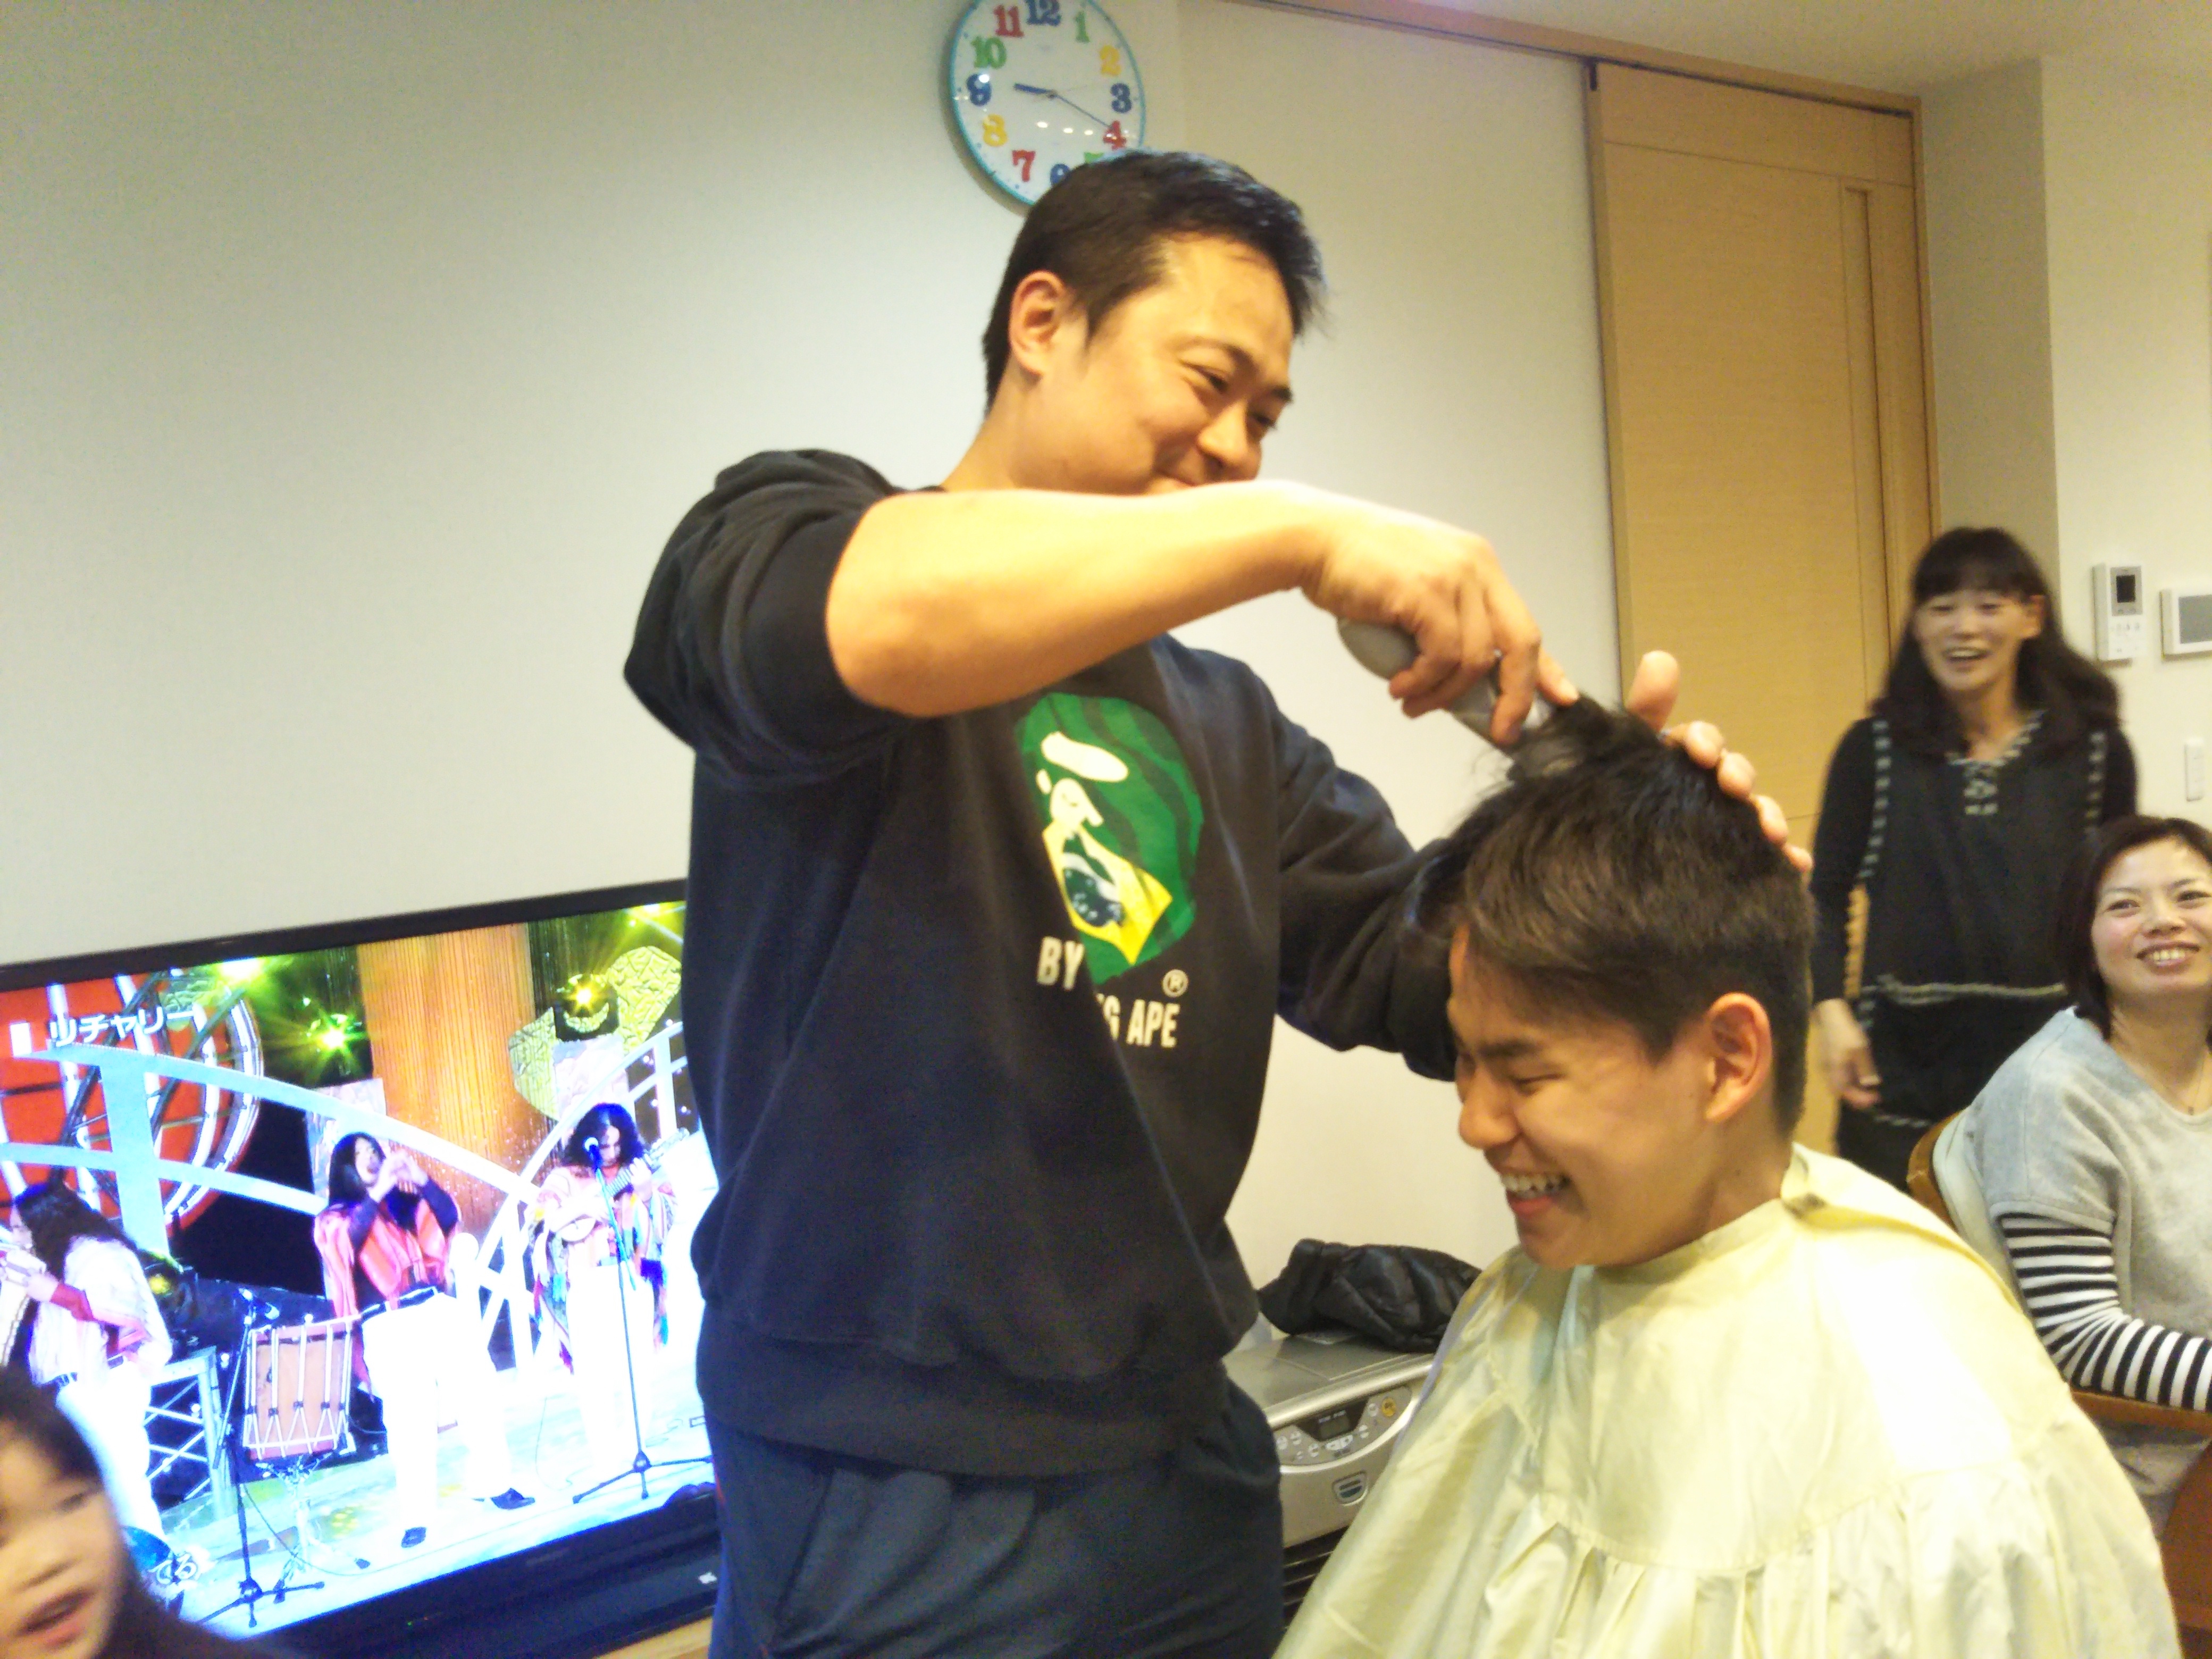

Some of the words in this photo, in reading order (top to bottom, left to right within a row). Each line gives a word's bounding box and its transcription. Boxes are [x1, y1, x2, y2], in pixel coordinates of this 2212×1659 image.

[993, 4, 1025, 38] 11
[1025, 0, 1062, 27] 12
[1074, 11, 1091, 43] 1
[970, 36, 1007, 69] 10
[1099, 45, 1121, 76] 2
[966, 73, 992, 106] 9
[1110, 83, 1132, 113] 3
[983, 114, 1008, 147] 8
[1102, 120, 1127, 150] 4
[1012, 149, 1036, 182] 7
[1036, 936, 1085, 990] BY
[1126, 999, 1181, 1048] APE
